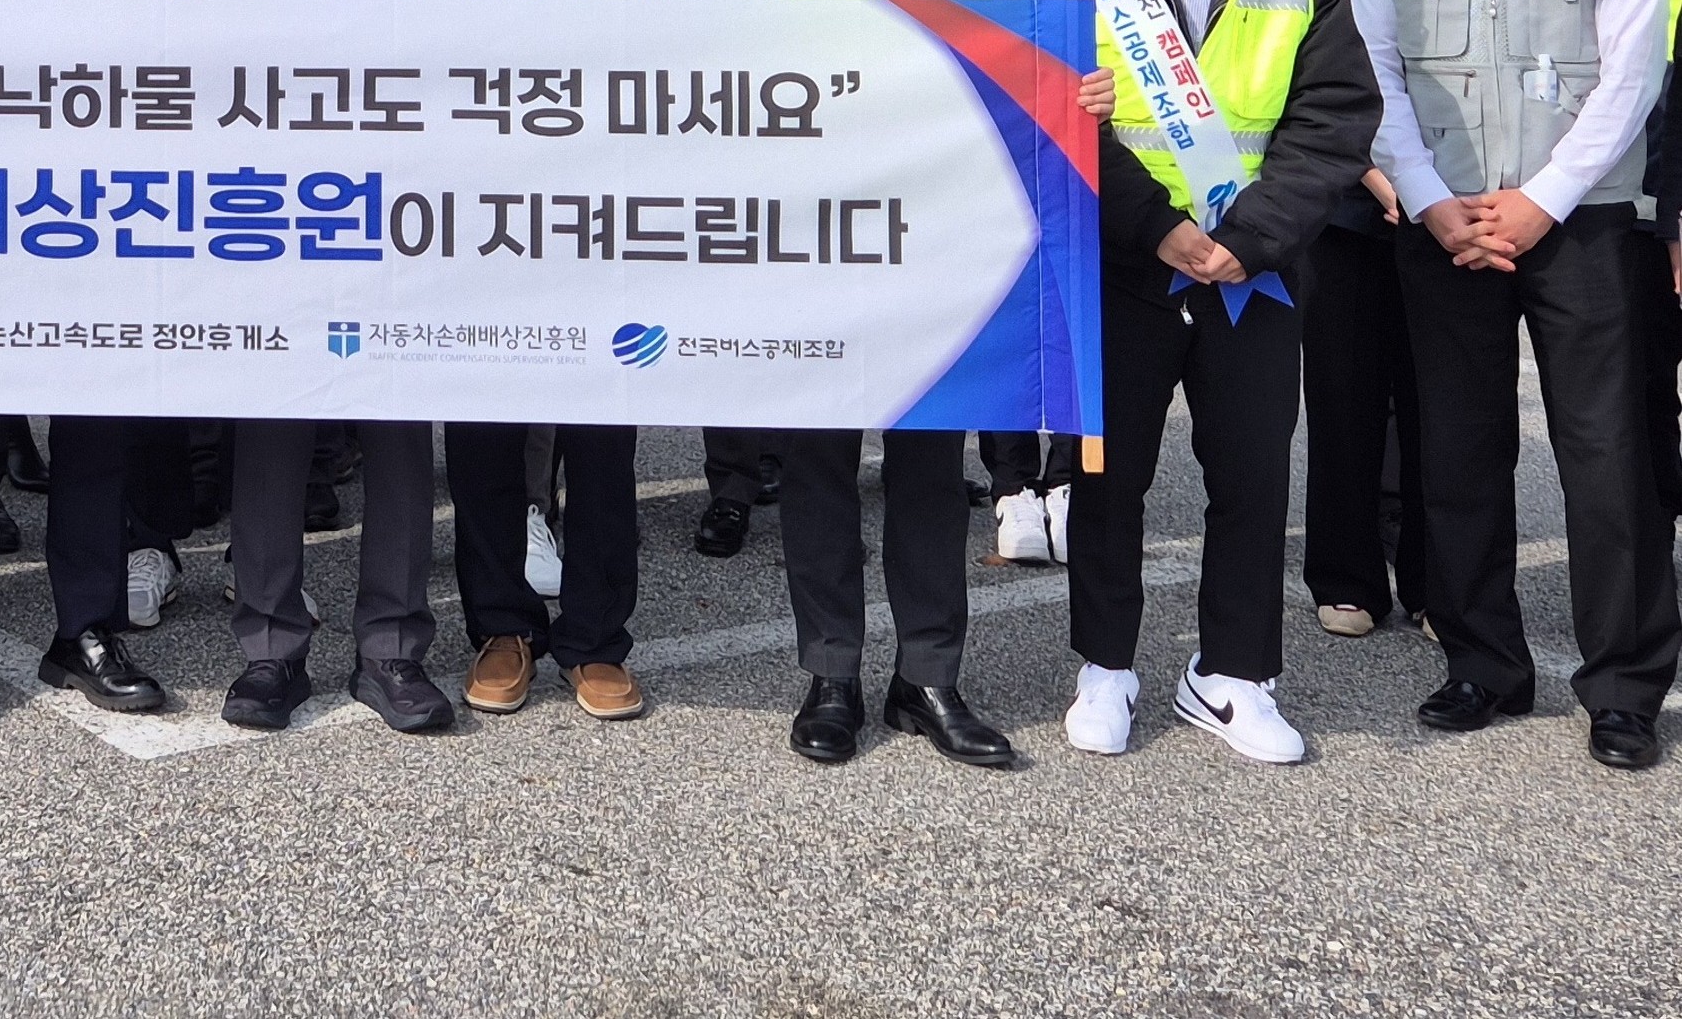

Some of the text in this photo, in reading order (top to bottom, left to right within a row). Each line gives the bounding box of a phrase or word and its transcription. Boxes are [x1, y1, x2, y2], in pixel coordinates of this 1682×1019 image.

[1155, 28, 1215, 119] 캠페인
[217, 65, 425, 132] 사고도
[448, 67, 585, 138] 걱정
[608, 69, 861, 139] 마세요”
[477, 193, 909, 266] 지켜드립니다
[152, 322, 290, 351] 정안휴게소
[368, 322, 587, 351] 자동차손해배상진흥원
[677, 337, 846, 361] 전국버스공제조합
